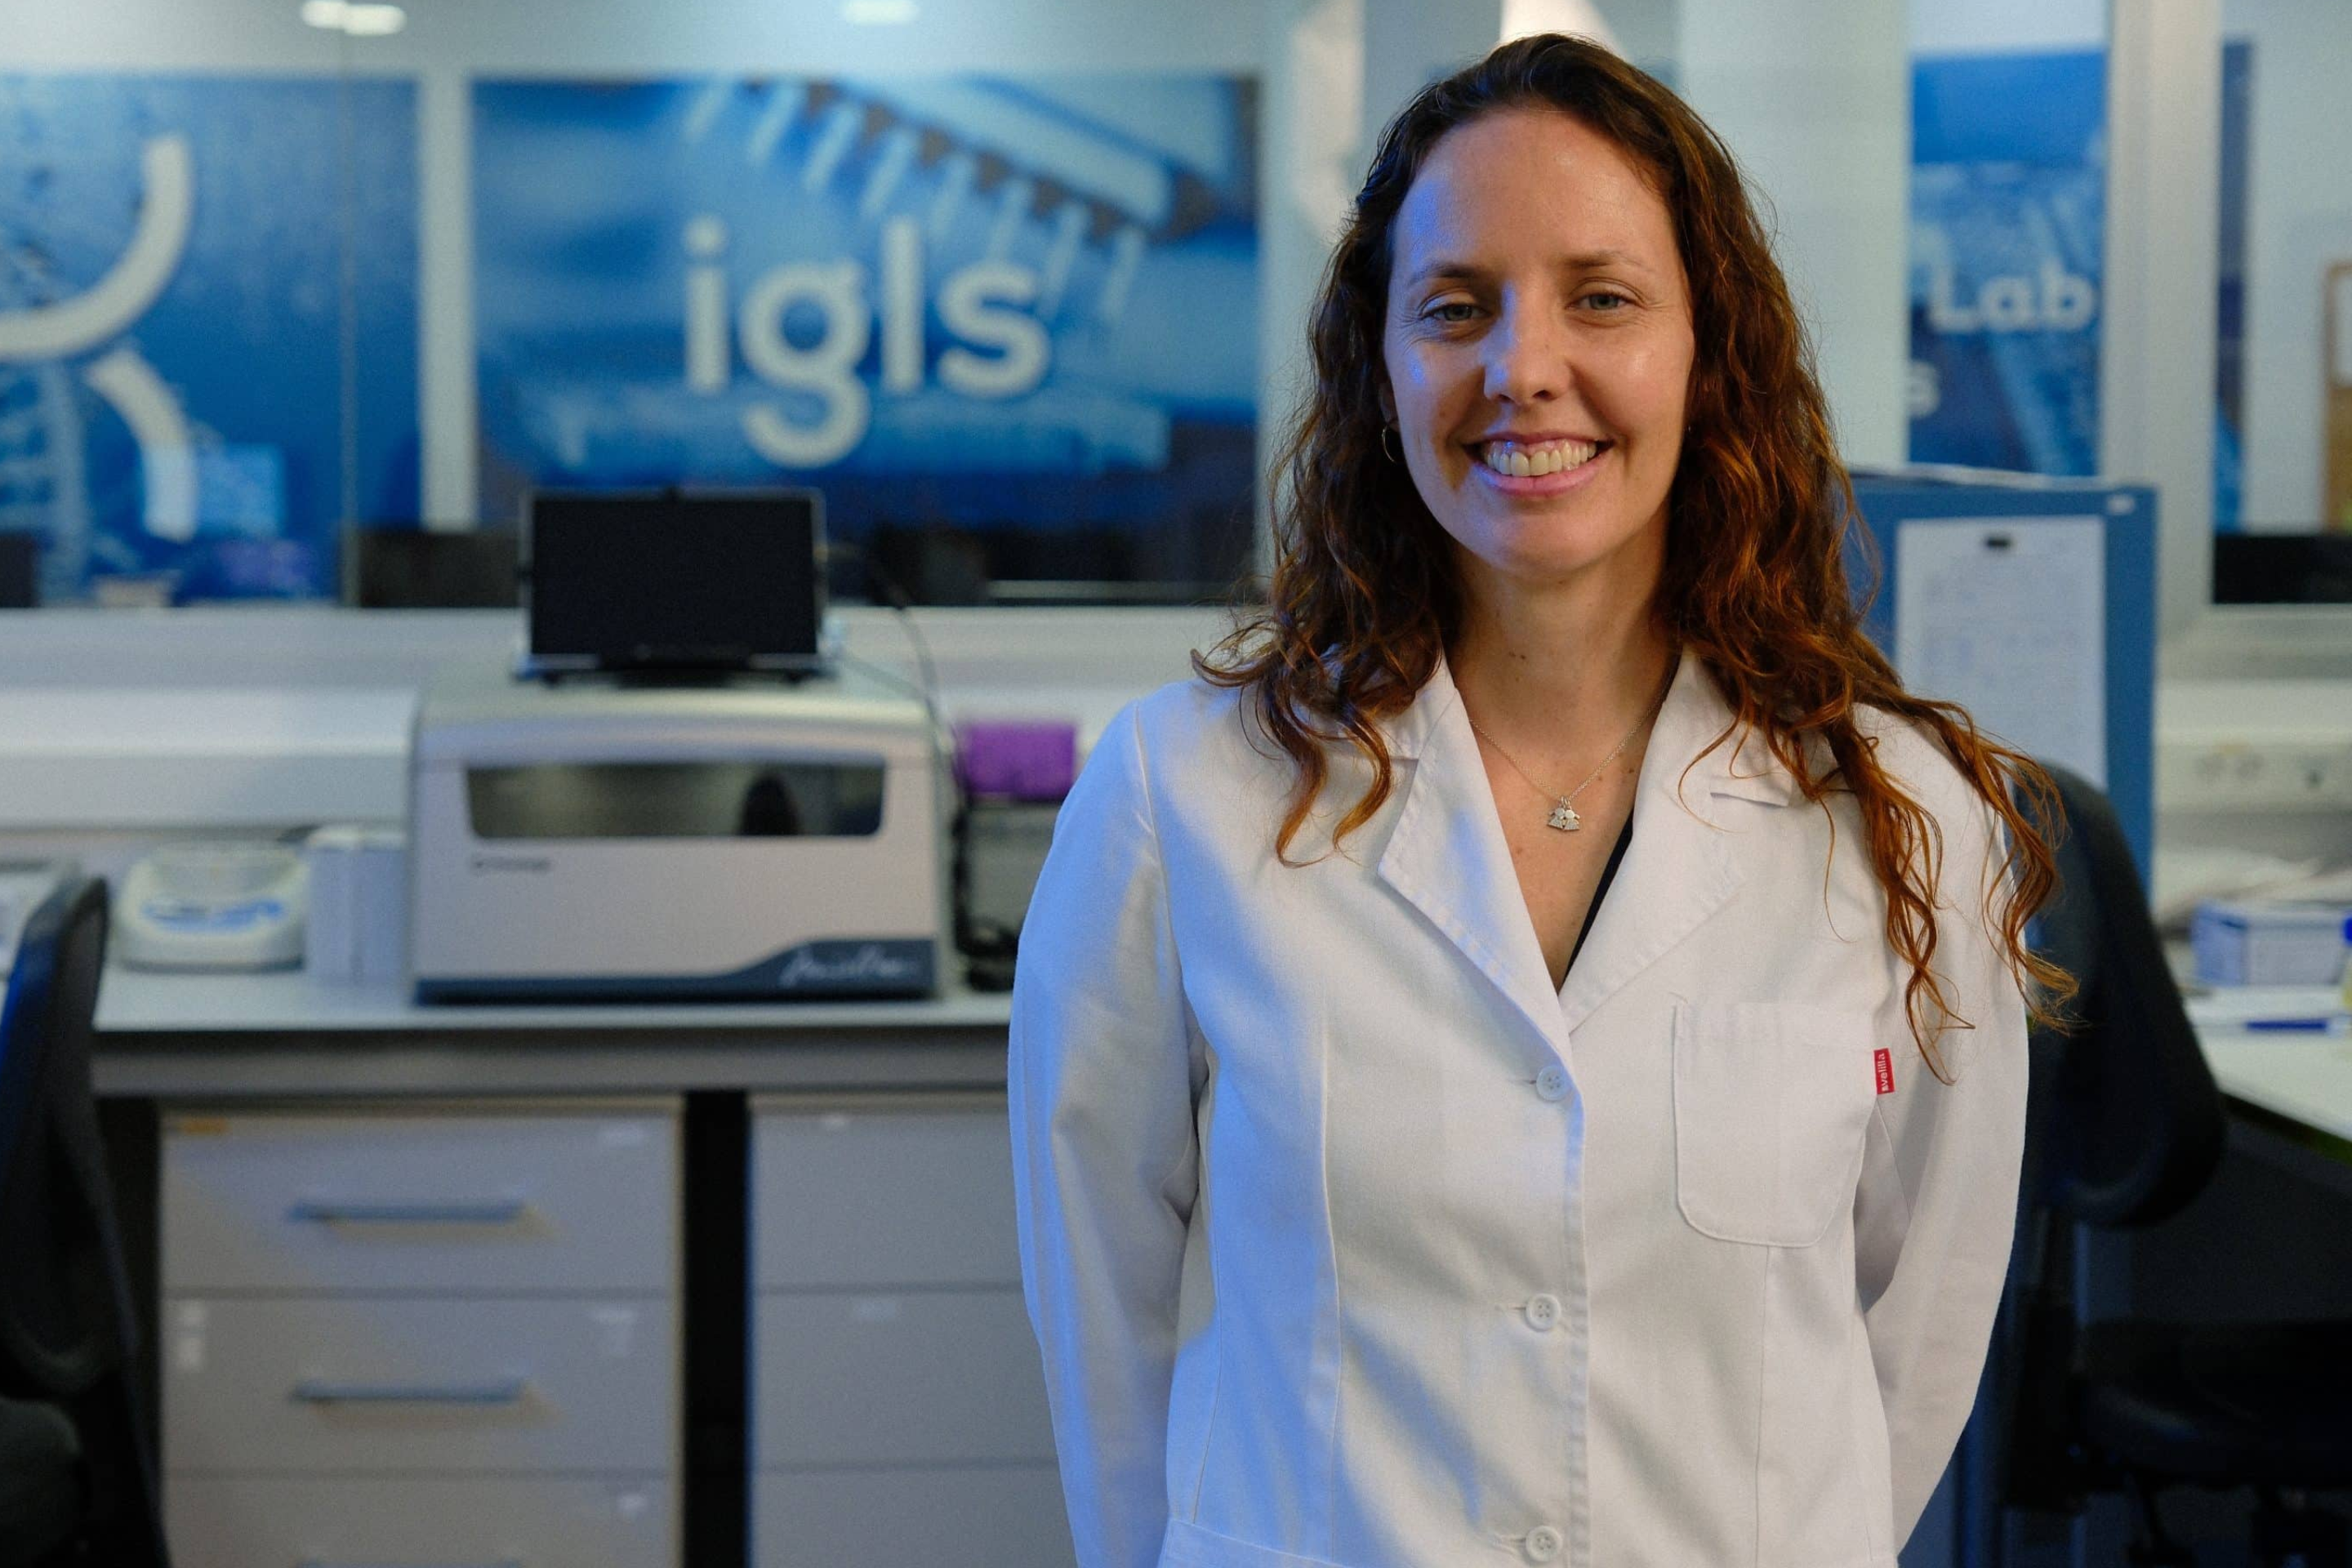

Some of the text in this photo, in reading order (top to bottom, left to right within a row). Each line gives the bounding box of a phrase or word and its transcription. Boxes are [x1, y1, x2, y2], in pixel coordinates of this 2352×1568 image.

[1930, 257, 2093, 332] Lab
[683, 214, 1050, 470] igls
[1878, 1053, 1888, 1087] velilla
